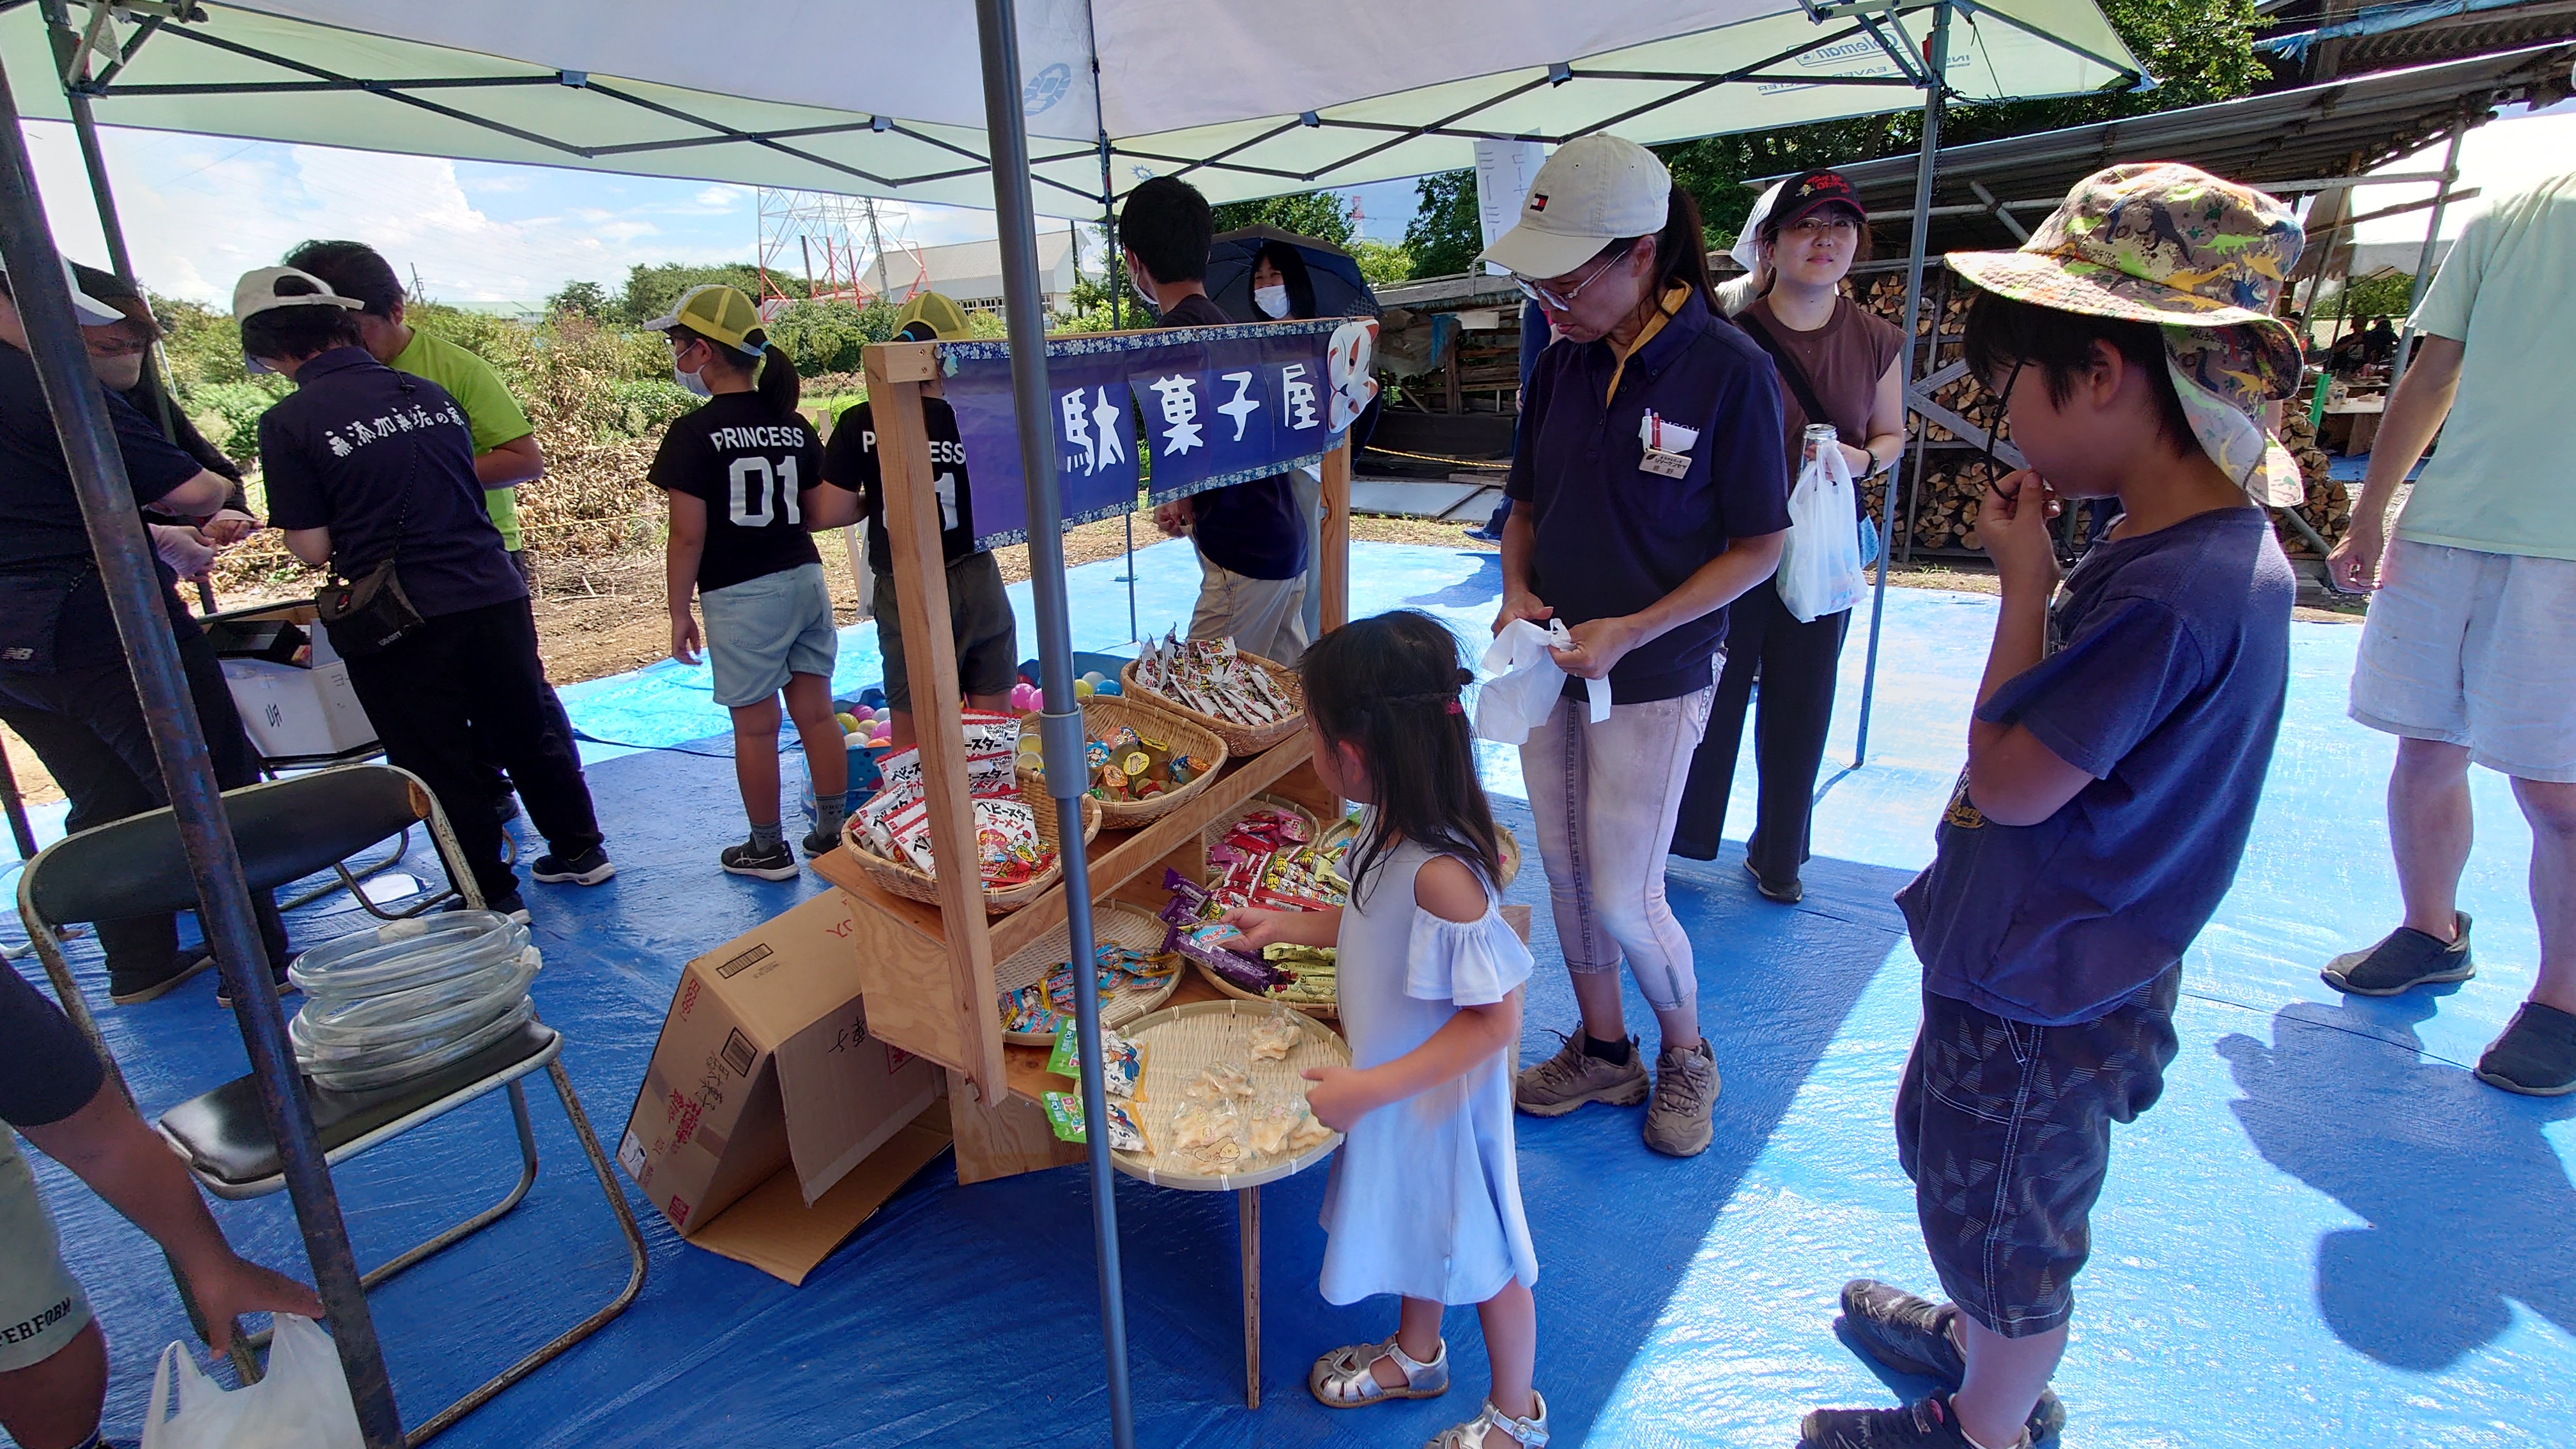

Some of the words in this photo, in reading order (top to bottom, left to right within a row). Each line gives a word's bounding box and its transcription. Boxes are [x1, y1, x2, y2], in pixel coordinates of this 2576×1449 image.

[1062, 363, 1319, 477] 駄菓子屋
[710, 426, 805, 452] PRINCESS
[862, 431, 966, 464] PESS
[729, 456, 800, 526] 01
[965, 737, 1002, 751] ースター
[891, 762, 921, 783] ベビース
[969, 769, 1010, 781] ースター
[907, 778, 924, 793] ラーメ
[977, 801, 1032, 821] ベビースター
[988, 813, 1025, 831] ラーメン
